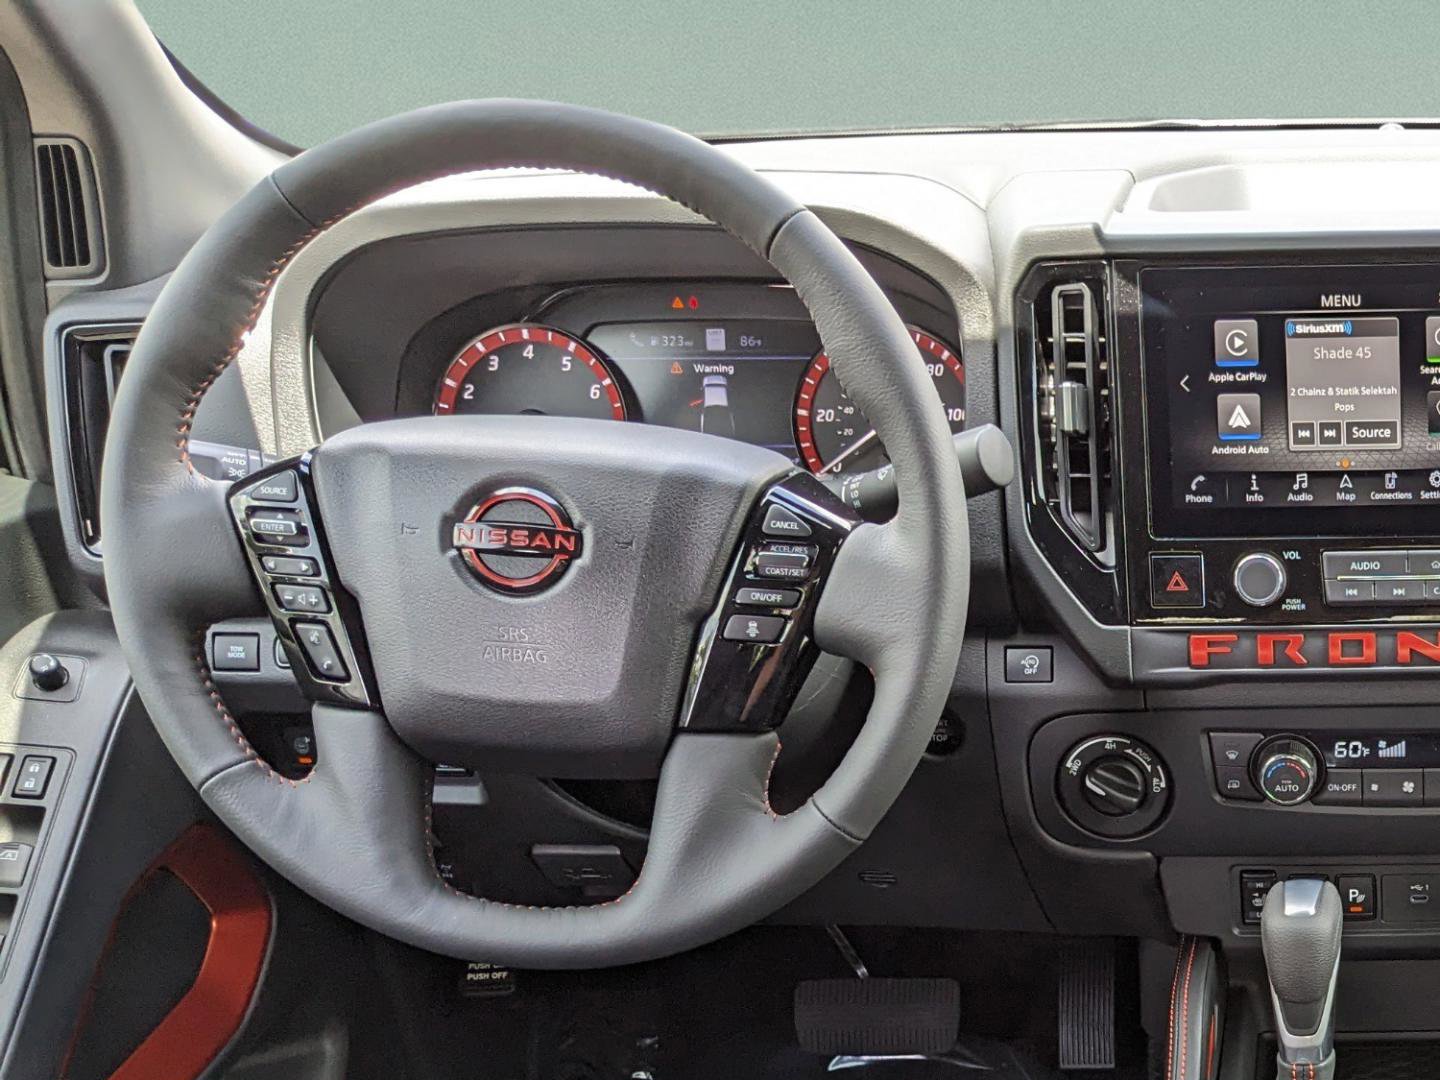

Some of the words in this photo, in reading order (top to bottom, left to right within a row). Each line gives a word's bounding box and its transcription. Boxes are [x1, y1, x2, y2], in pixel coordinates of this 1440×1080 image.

[1321, 295, 1361, 307] MENU
[523, 345, 534, 359] 4
[1314, 347, 1352, 359] Shade
[1356, 347, 1371, 358] 45
[488, 356, 499, 371] 3
[561, 357, 572, 371] 5
[693, 364, 735, 375] Warning
[1208, 372, 1234, 383] Apple
[1235, 372, 1267, 382] CarPlay
[463, 385, 474, 399] 2
[590, 385, 601, 399] 6
[1290, 388, 1295, 396] 2
[1297, 388, 1325, 396] Chainz
[1328, 388, 1333, 396] &
[1335, 387, 1359, 396] Statik
[1361, 386, 1397, 395] Selektah
[1335, 403, 1355, 413] Pops
[816, 410, 834, 422] 20
[1352, 426, 1391, 438] Source
[1212, 445, 1246, 454] Android
[1248, 446, 1269, 454] Auto
[1426, 443, 1440, 451] Call
[260, 487, 287, 495] SOURCE
[1370, 491, 1413, 500] Connections
[1185, 494, 1213, 503] Phone
[1246, 493, 1264, 502] Info
[1287, 492, 1313, 502] Audio
[1336, 492, 1356, 503] Map
[261, 523, 284, 531] ENTER
[770, 521, 799, 529] CANCEL
[458, 528, 575, 550] NISSAN
[1282, 551, 1301, 560] VOL
[1350, 561, 1380, 570] AUDIO
[765, 568, 804, 576] COAST/SET
[751, 593, 782, 602] ON/OFF
[498, 627, 529, 641] SRS
[482, 648, 547, 664] AIRBAG
[1069, 760, 1081, 776] 2WD
[1275, 784, 1298, 792] AUTO
[467, 972, 489, 981] PUSH
[491, 971, 508, 979] OFF
